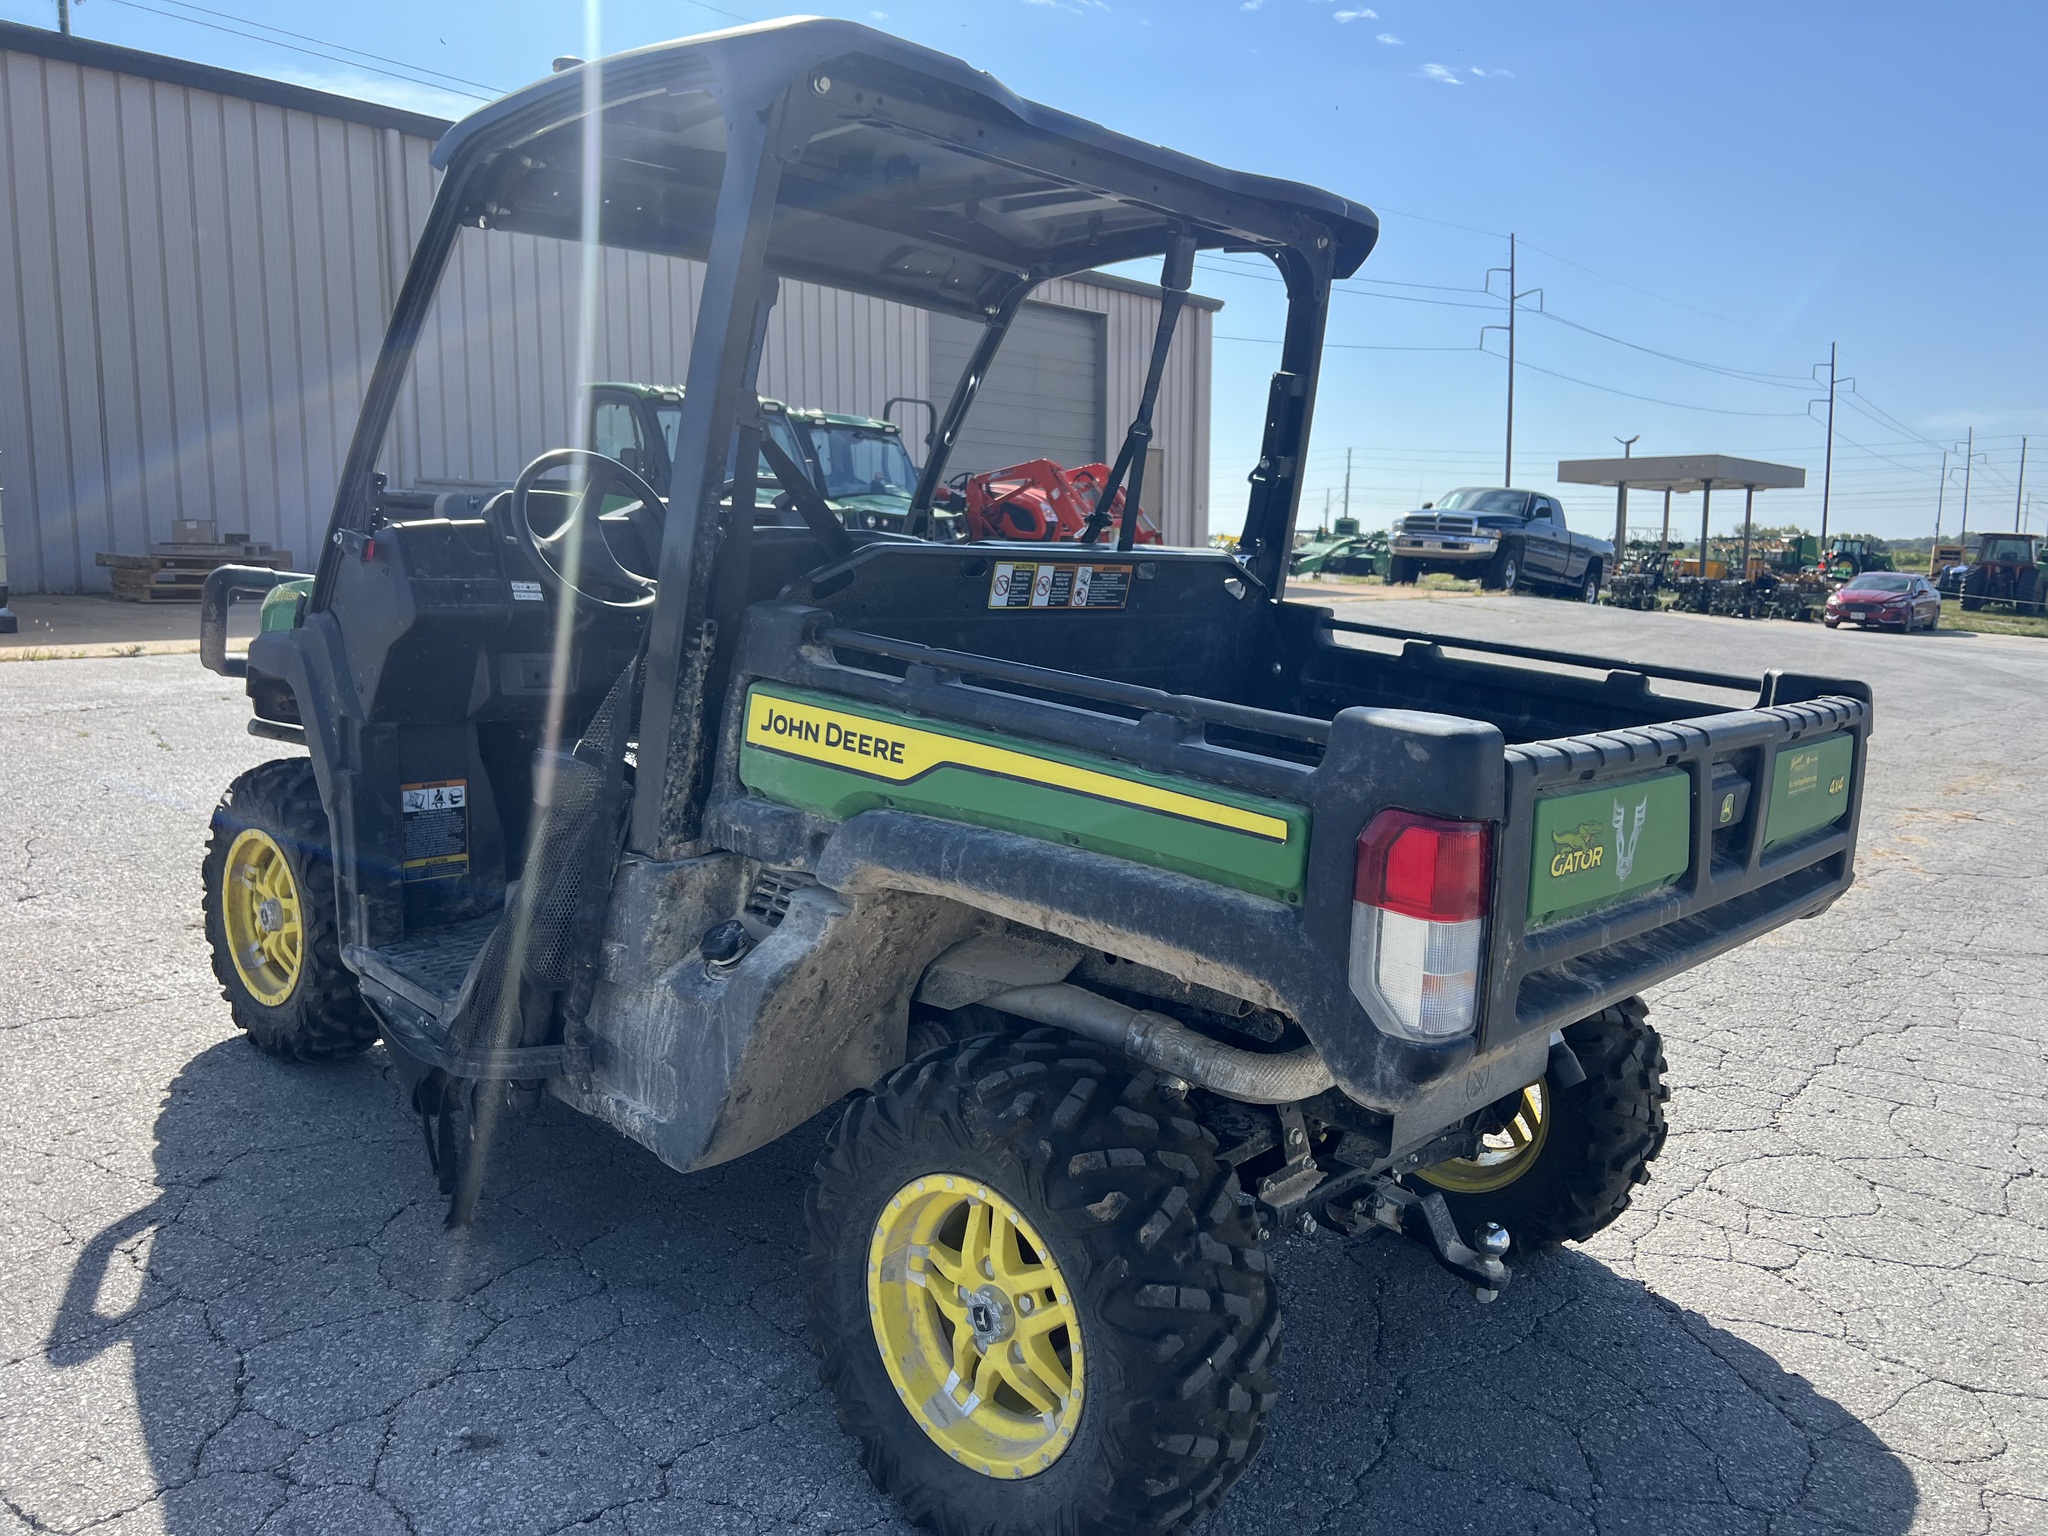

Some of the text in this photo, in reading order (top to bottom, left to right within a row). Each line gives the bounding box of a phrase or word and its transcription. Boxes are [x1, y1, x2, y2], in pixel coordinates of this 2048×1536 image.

[760, 708, 906, 764] JOHN DEERE
[1550, 845, 1604, 878] GATOR
